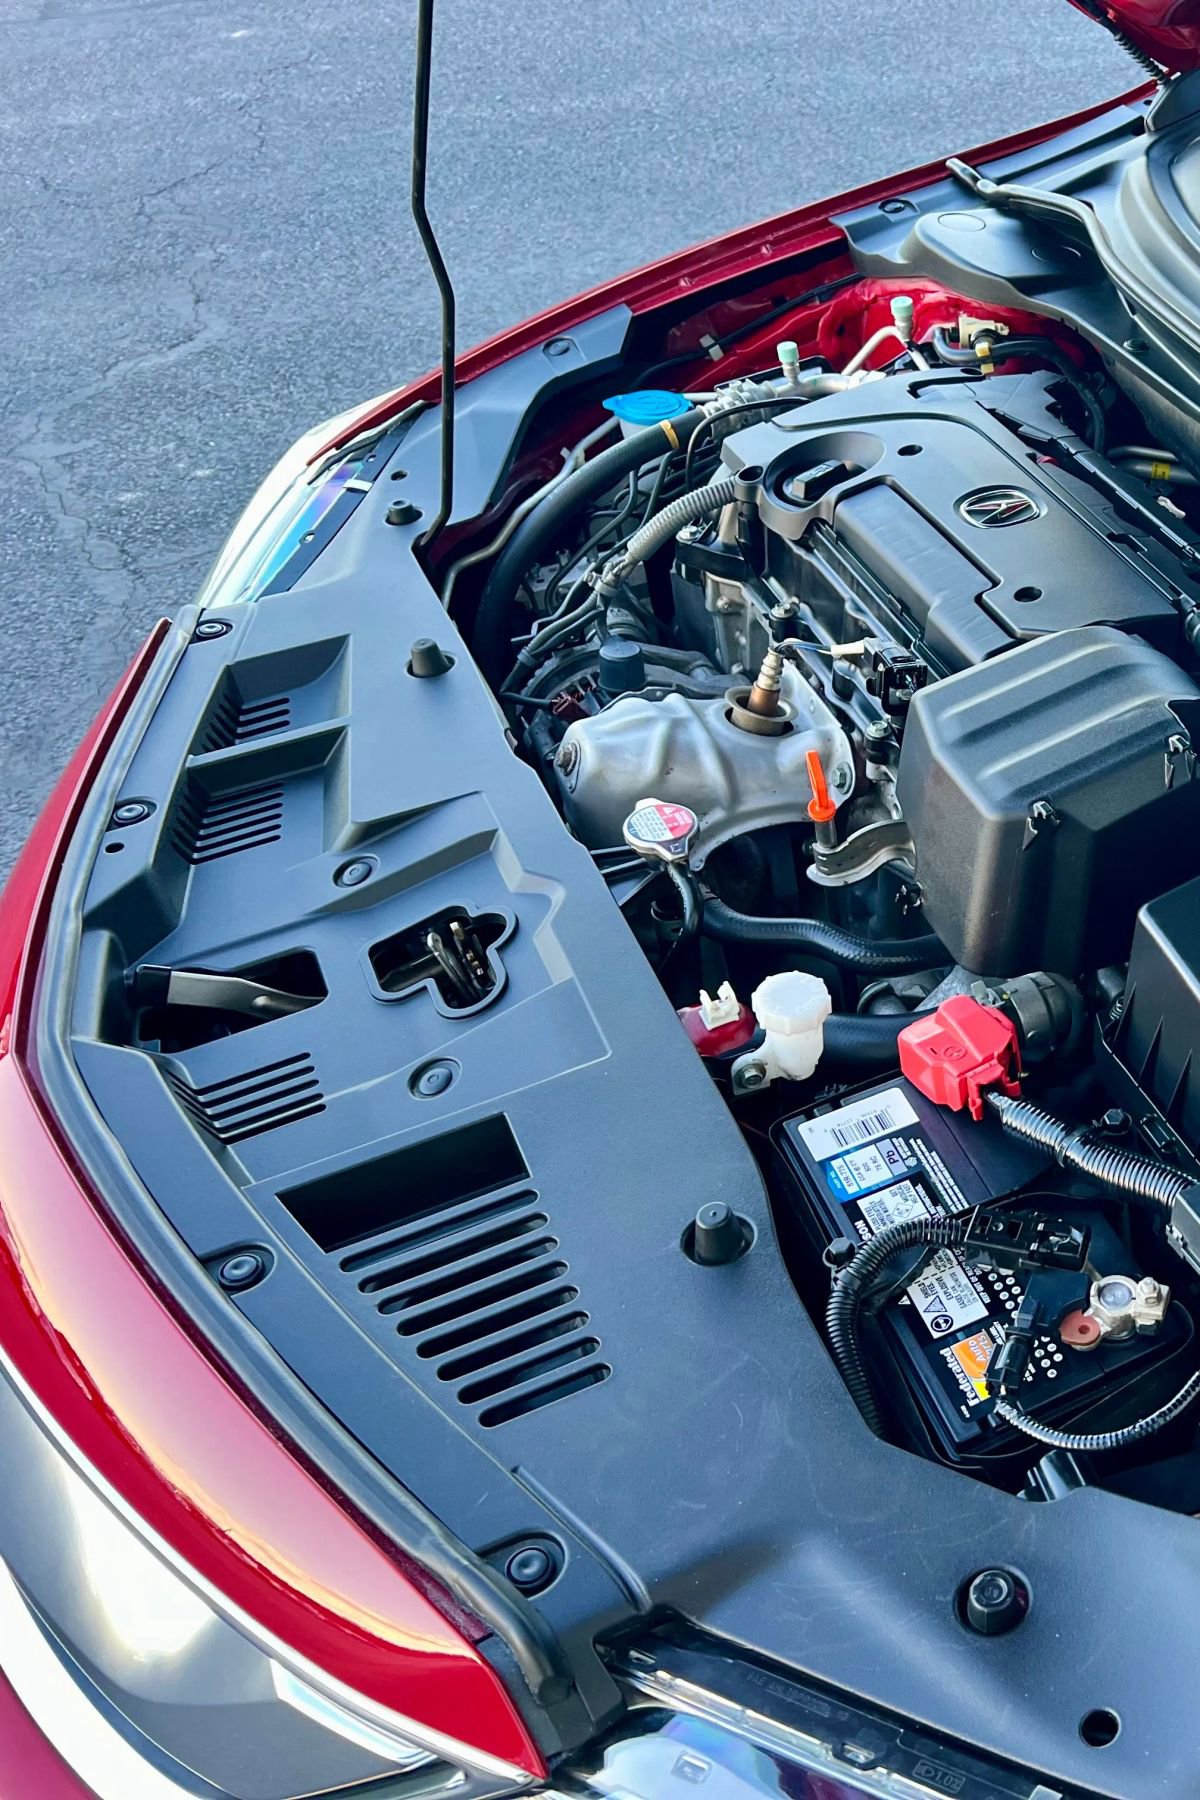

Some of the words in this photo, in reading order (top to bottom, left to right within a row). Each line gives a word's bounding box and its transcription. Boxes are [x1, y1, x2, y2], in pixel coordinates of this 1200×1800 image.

[883, 1149, 899, 1164] Pb
[917, 1282, 931, 1298] SHIELD
[934, 1275, 953, 1300] EXPLOSIVE
[973, 1281, 984, 1292] OUT
[966, 1339, 986, 1362] Auto
[974, 1334, 995, 1358] arts
[939, 1348, 980, 1406] Federated
